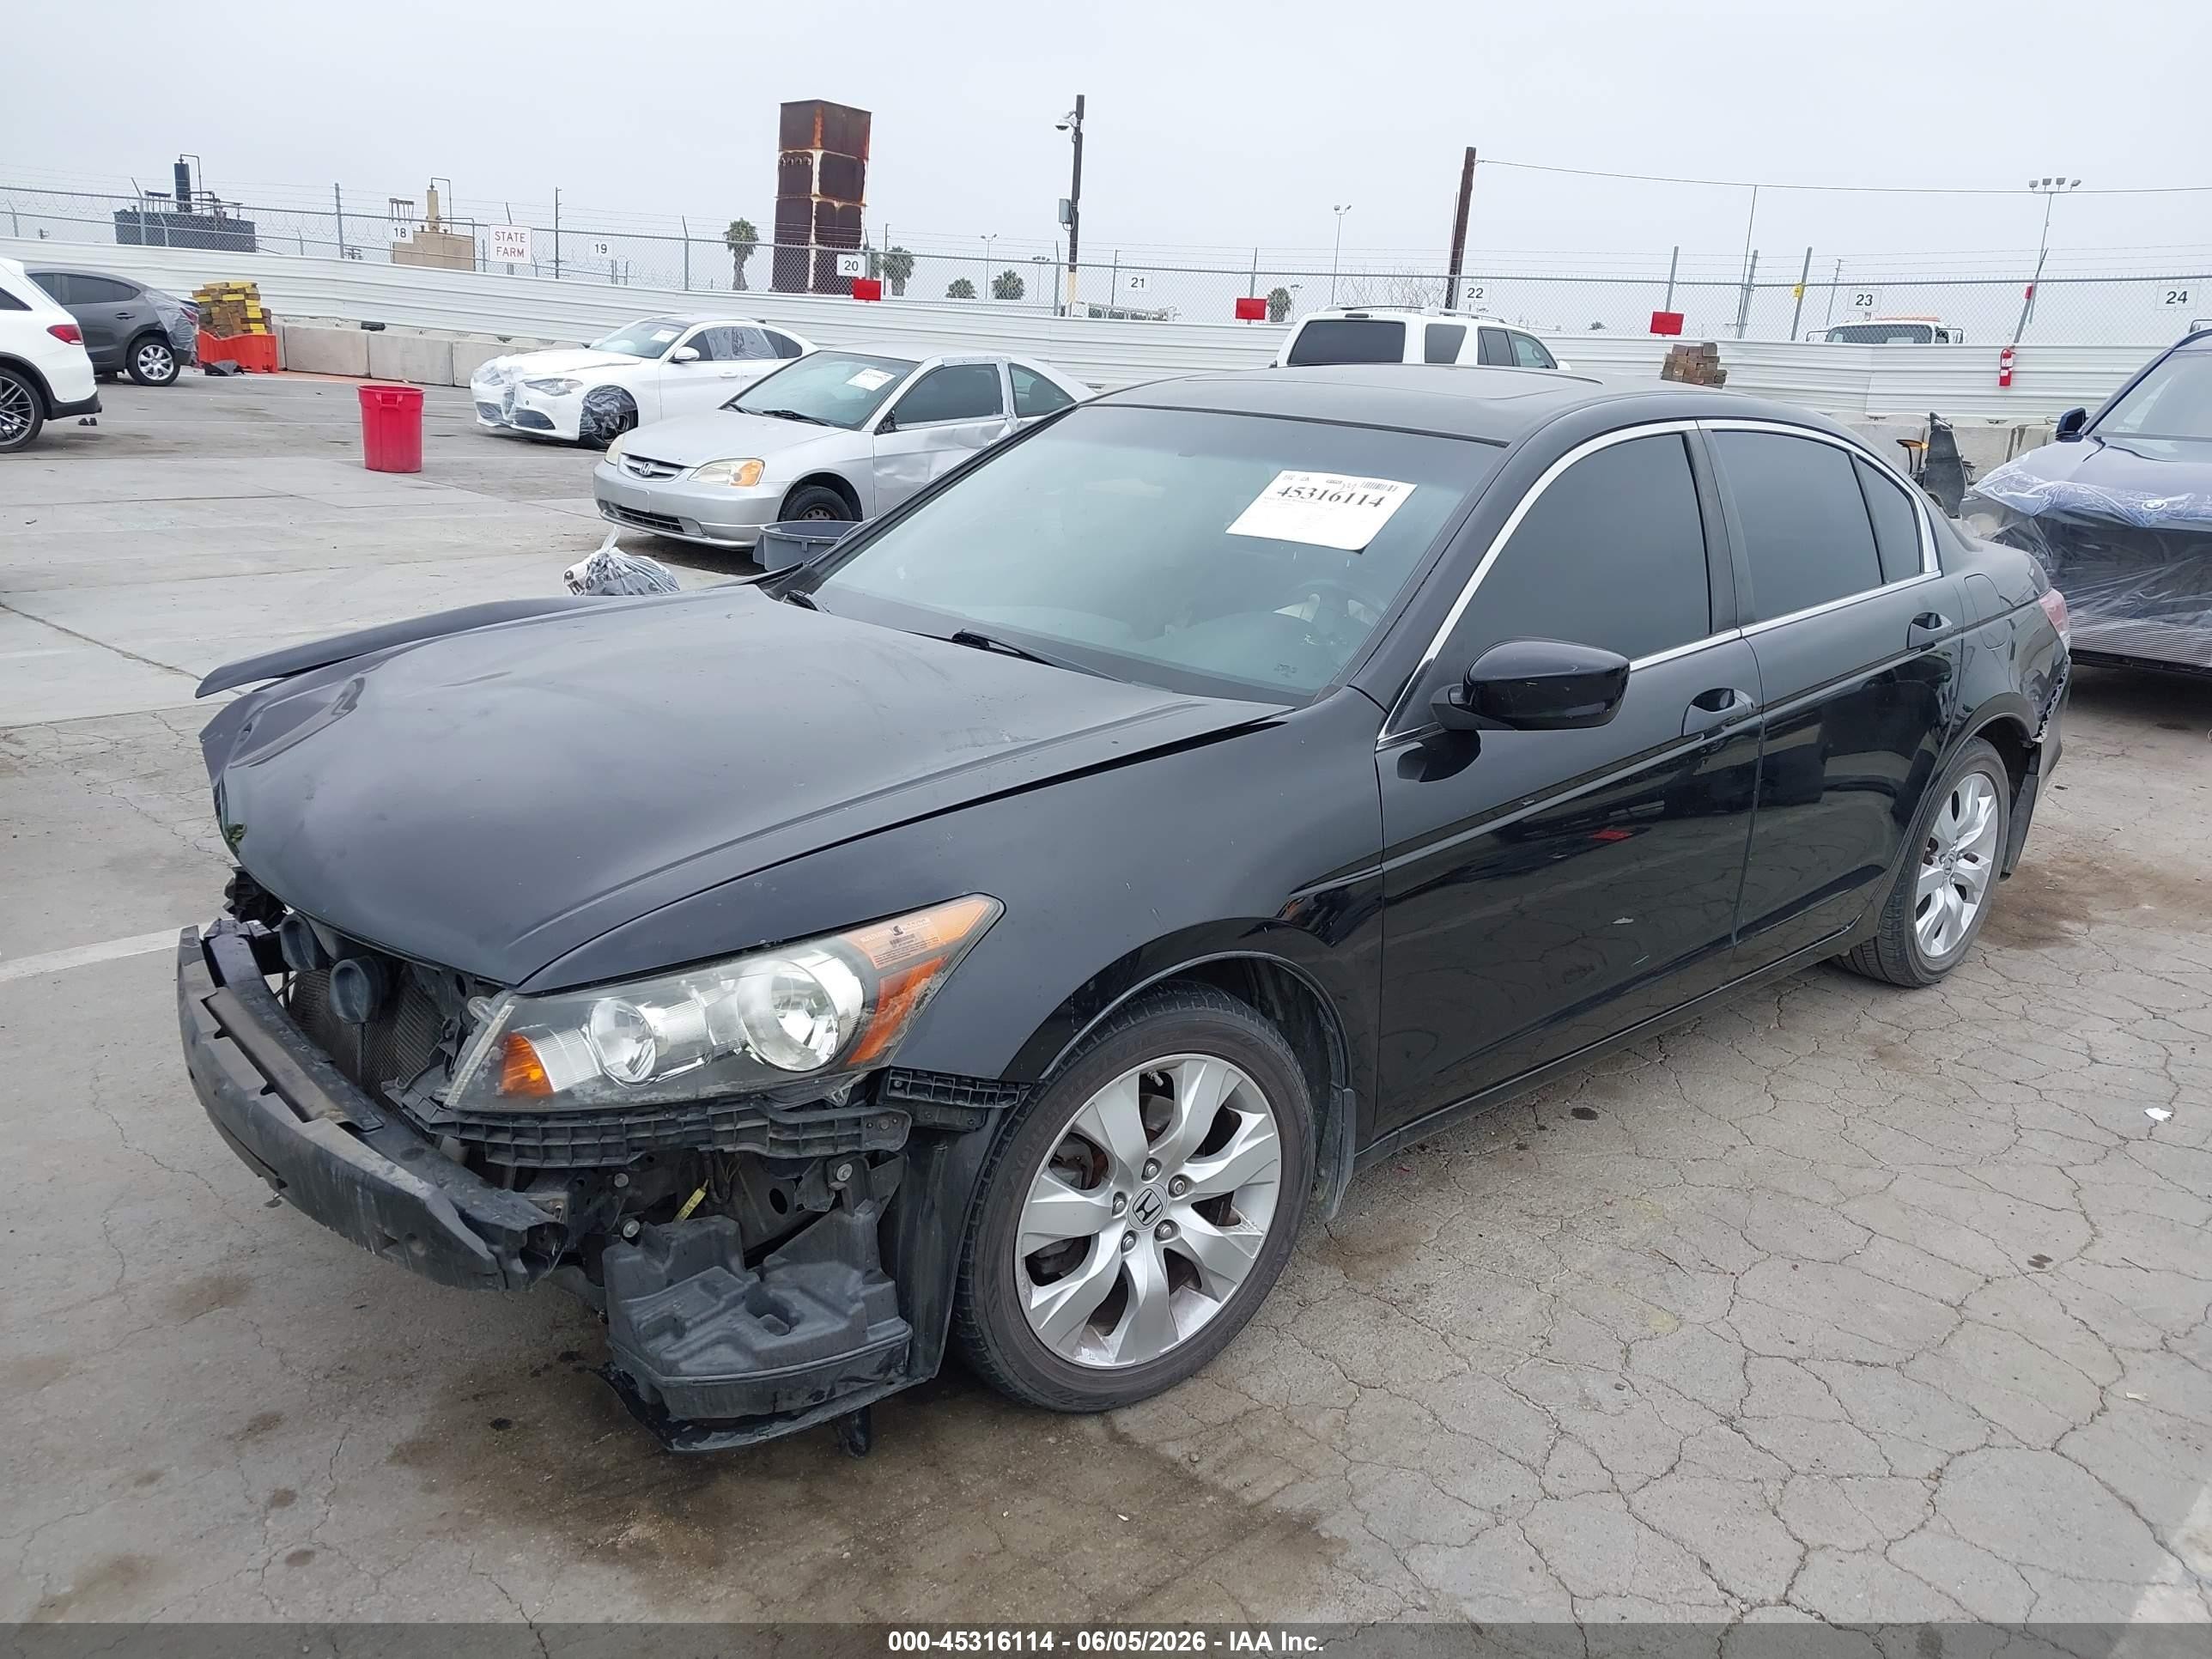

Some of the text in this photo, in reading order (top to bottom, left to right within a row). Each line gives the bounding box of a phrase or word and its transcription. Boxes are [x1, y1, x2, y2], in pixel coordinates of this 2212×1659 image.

[393, 227, 407, 238] 18
[495, 231, 526, 243] STATE
[496, 246, 525, 258] FARM
[594, 244, 608, 254] 19
[844, 259, 859, 271] 20
[1130, 276, 1145, 289] 21
[1467, 287, 1484, 299] 22
[2165, 290, 2188, 305] 24
[1855, 294, 1873, 307] 23
[1277, 486, 1386, 507] 45316114
